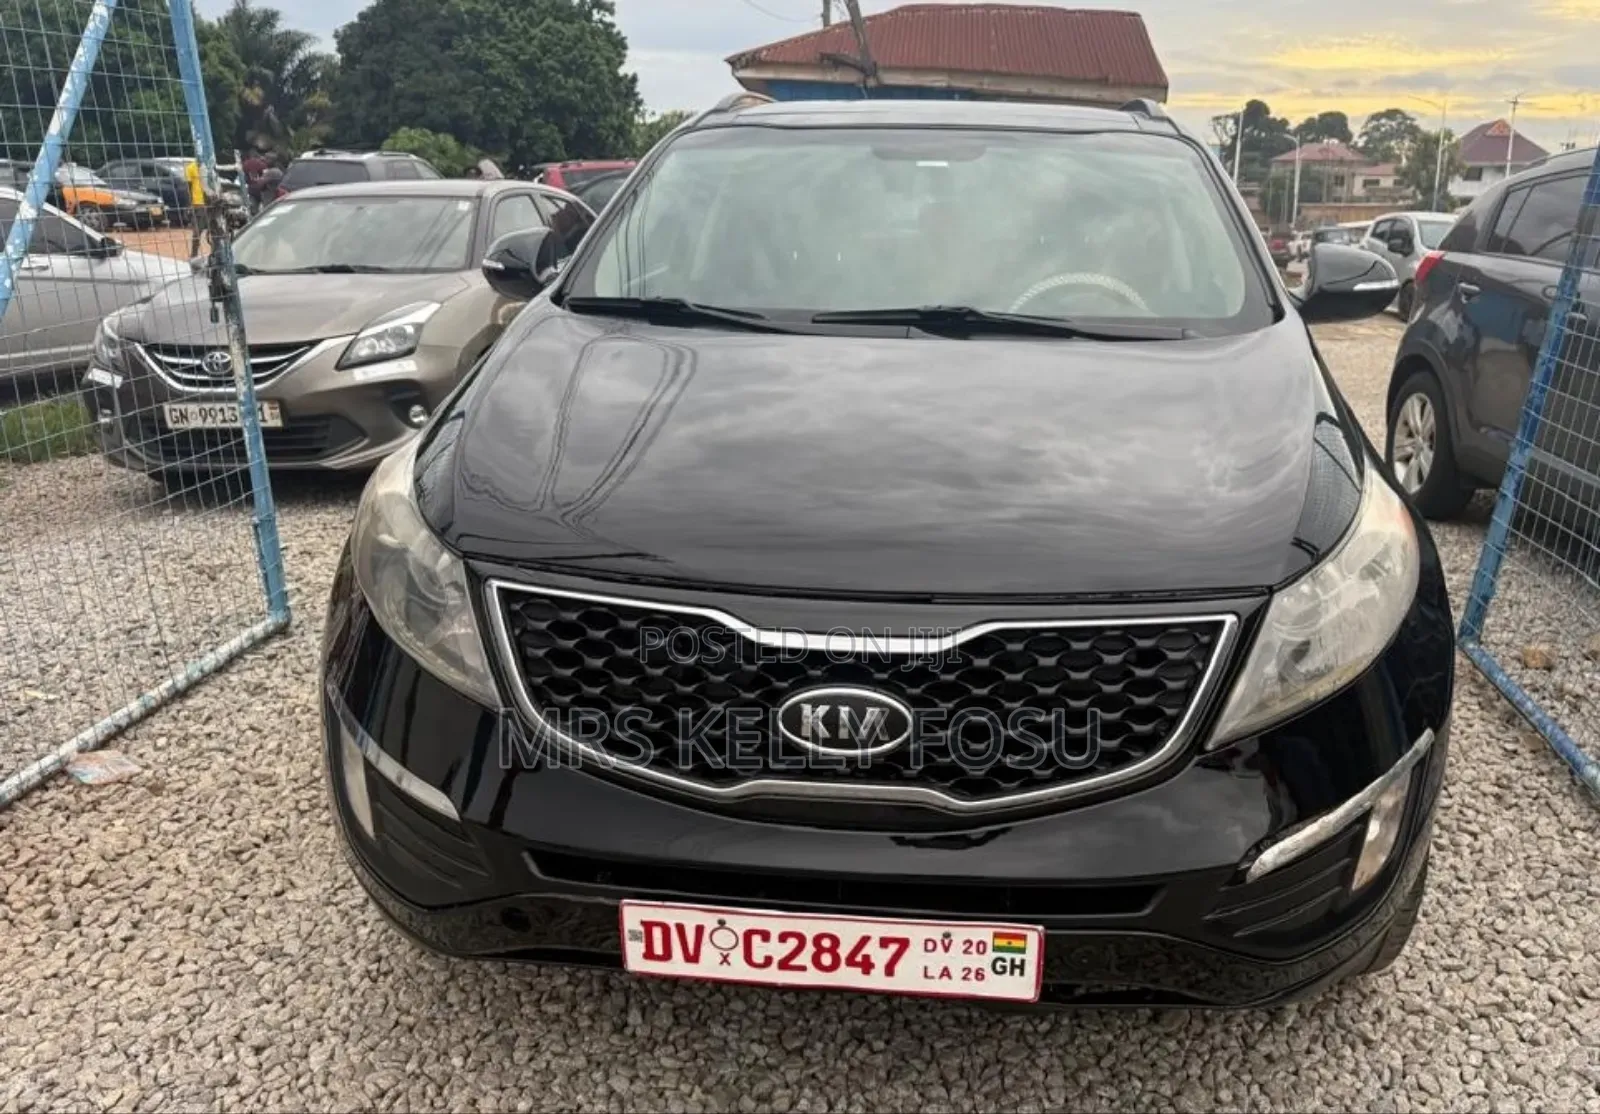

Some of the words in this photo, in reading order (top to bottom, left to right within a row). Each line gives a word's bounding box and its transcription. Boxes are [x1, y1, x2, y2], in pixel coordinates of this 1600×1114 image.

[169, 407, 188, 424] GN
[640, 920, 705, 964] DV
[743, 928, 910, 977] C2847
[923, 938, 953, 953] DV
[962, 939, 987, 955] 20
[961, 967, 986, 981] 26
[991, 957, 1026, 976] GH
